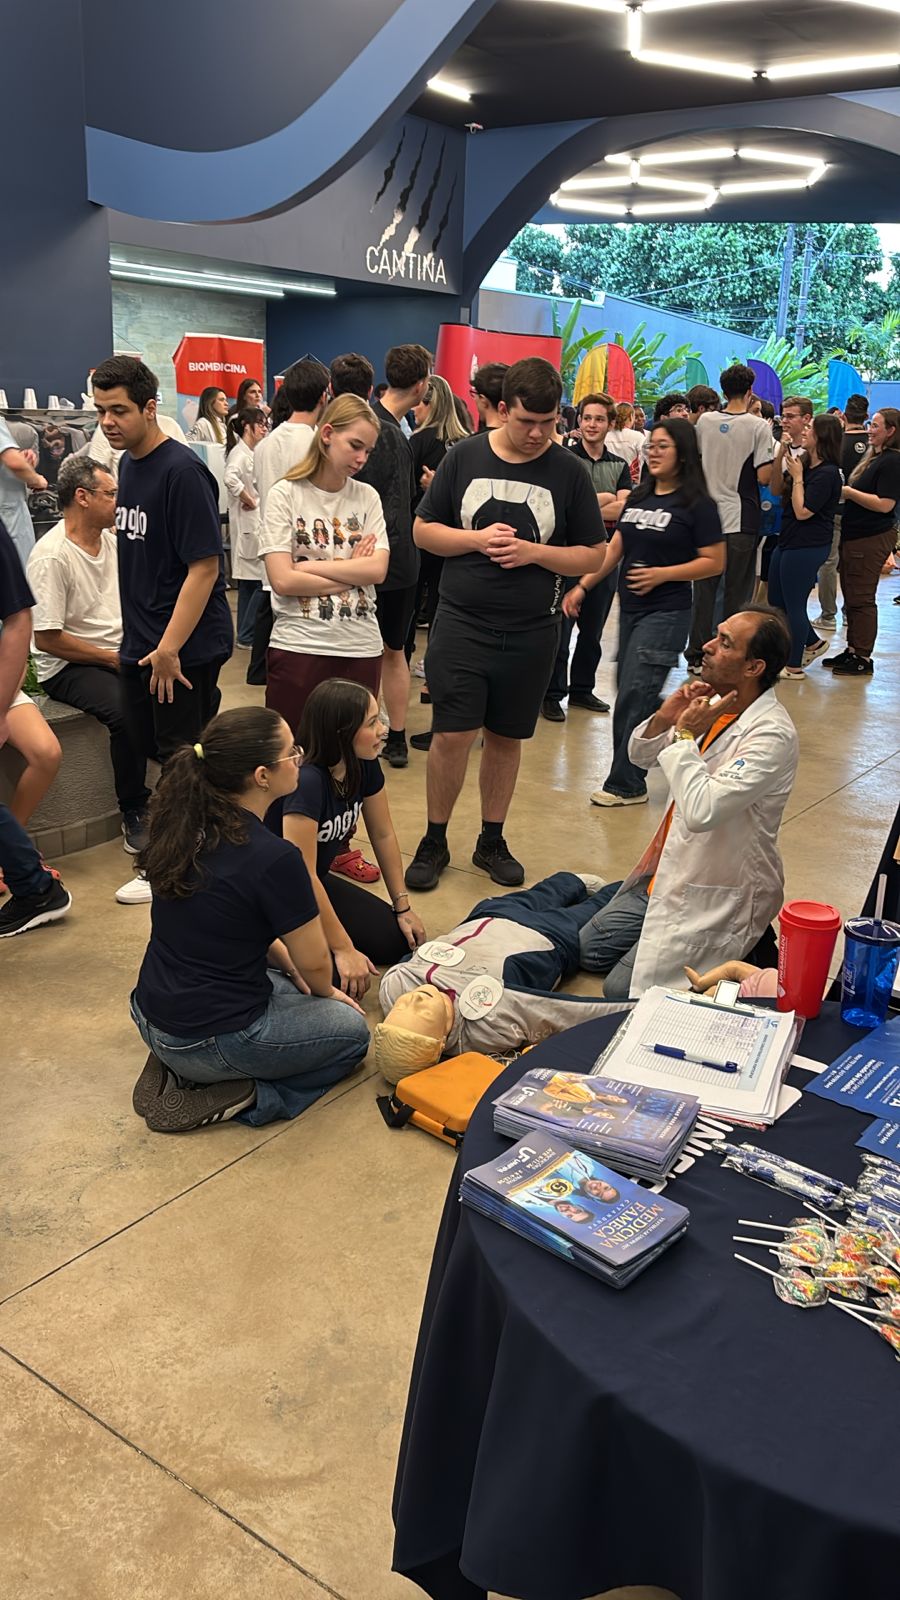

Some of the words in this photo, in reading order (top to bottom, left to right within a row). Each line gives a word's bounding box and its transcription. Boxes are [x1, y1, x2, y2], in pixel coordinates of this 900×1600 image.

[366, 246, 447, 285] CANTINA
[620, 507, 673, 532] anglo
[552, 1182, 566, 1193] 5
[592, 1201, 647, 1239] FAMECA
[600, 1203, 664, 1249] MEDICINA
